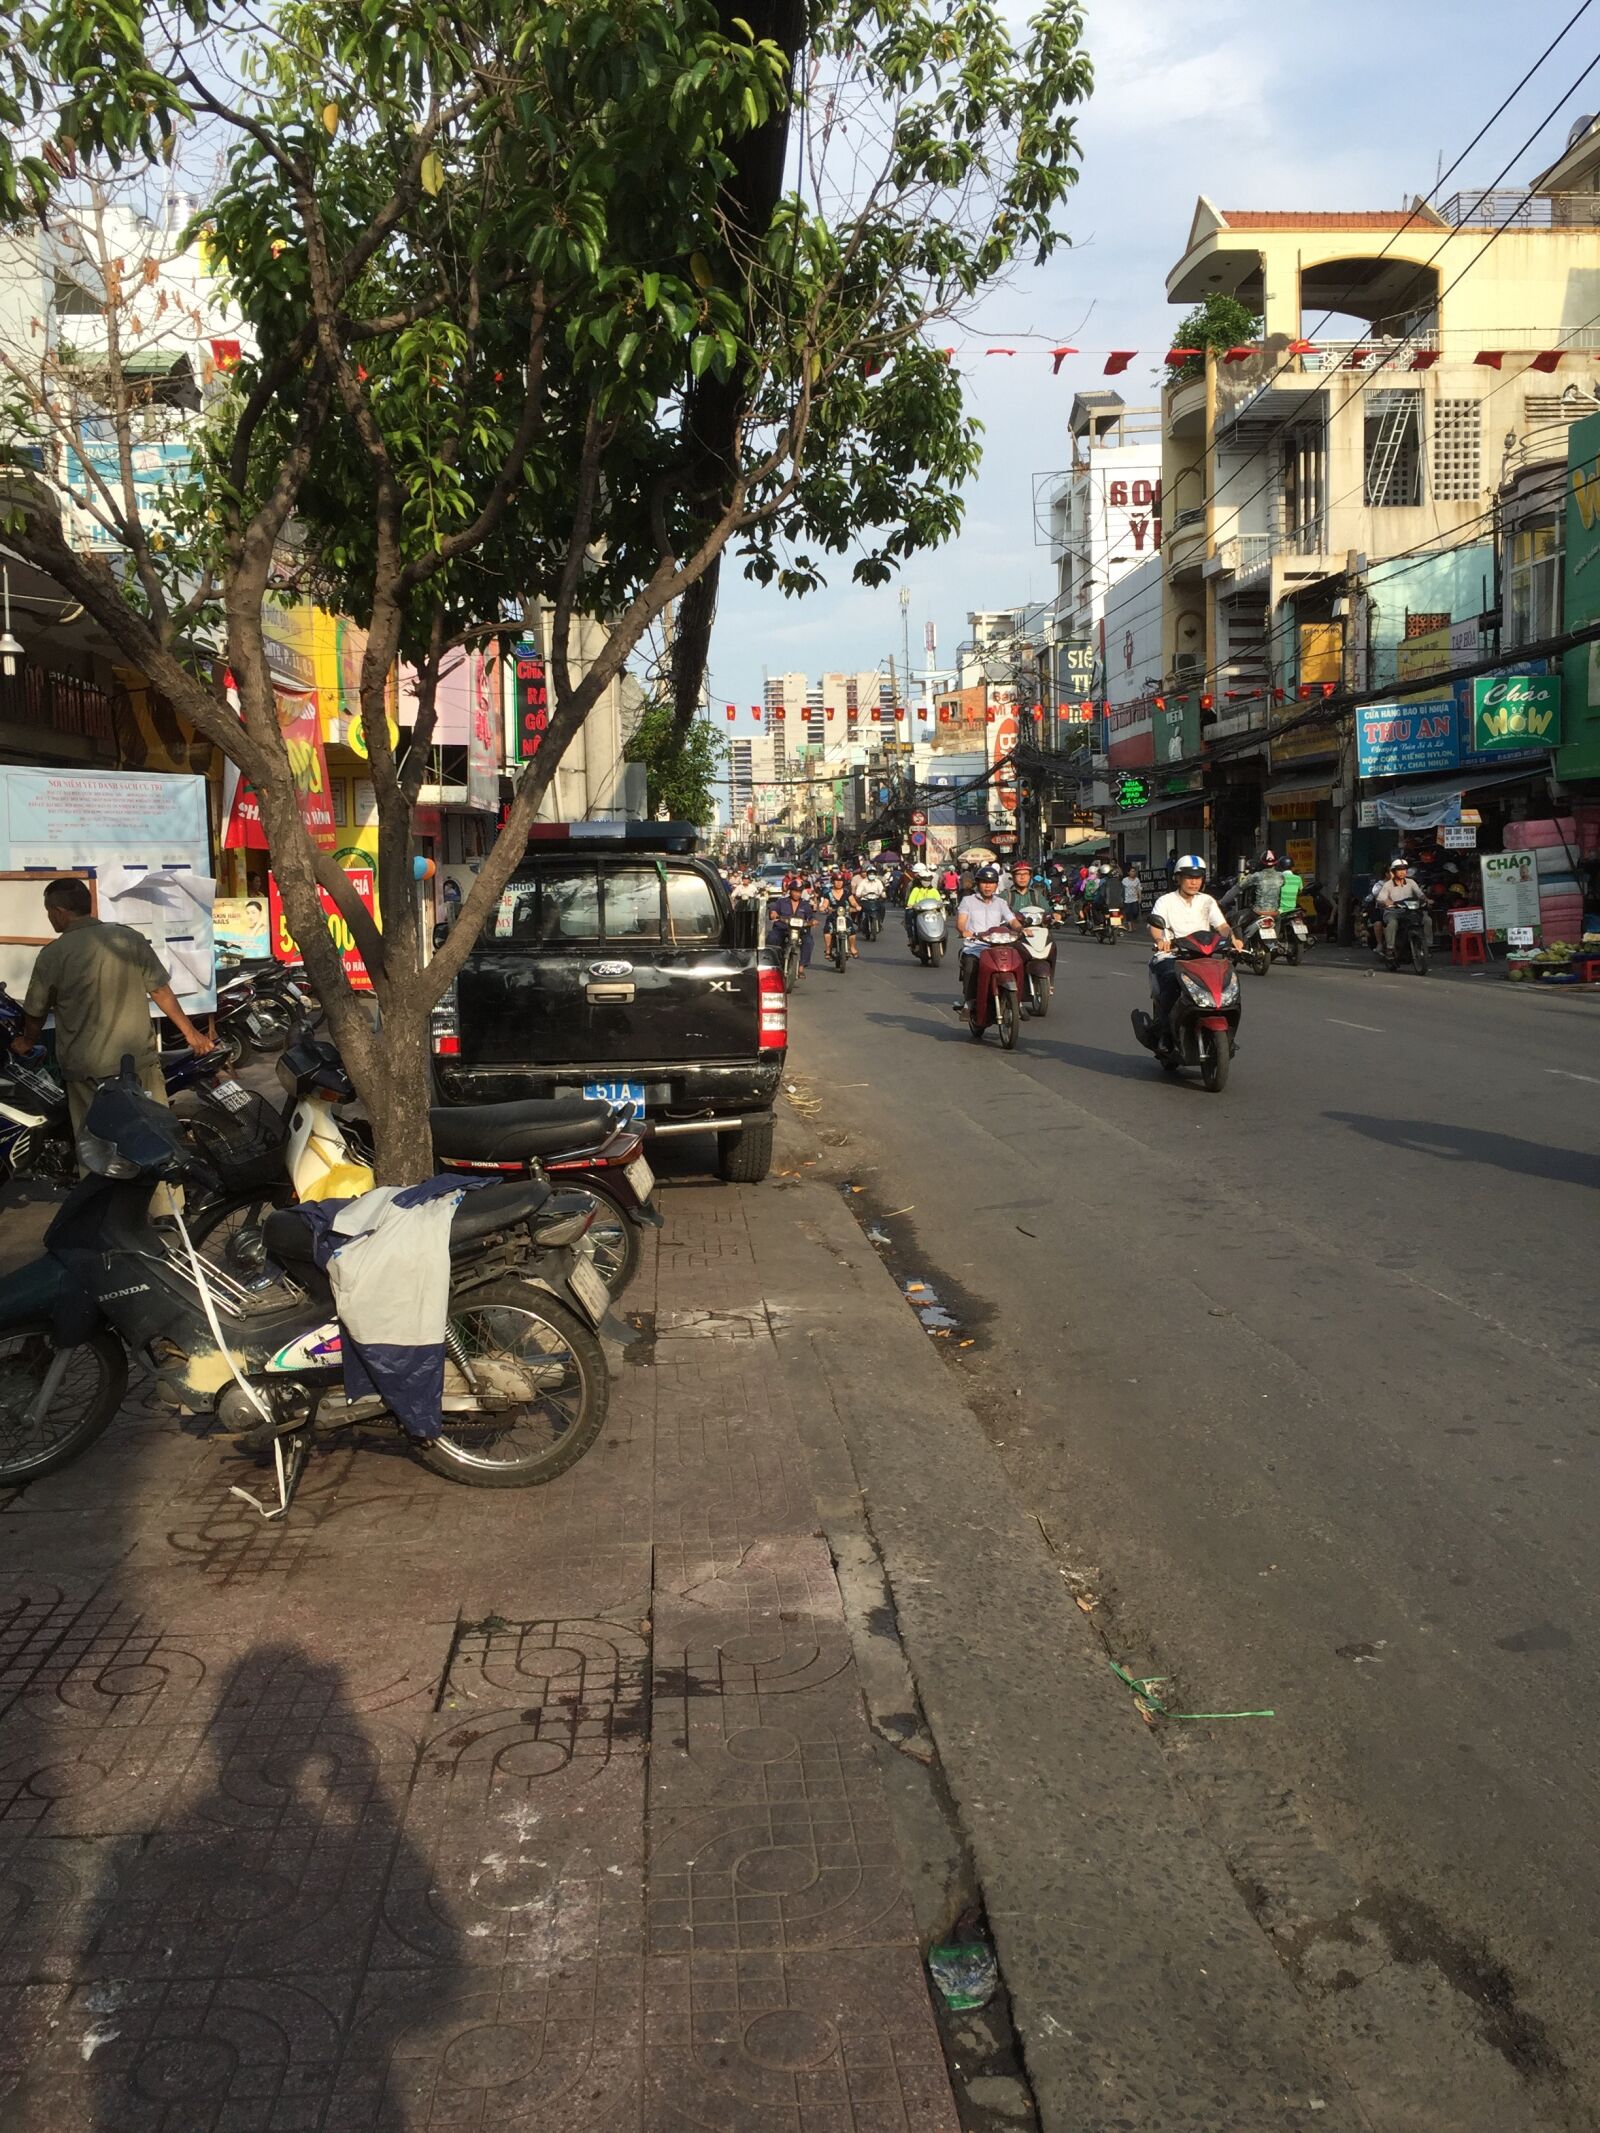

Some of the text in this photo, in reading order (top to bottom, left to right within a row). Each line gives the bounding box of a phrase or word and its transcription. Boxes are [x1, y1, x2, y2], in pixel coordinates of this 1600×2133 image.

[1483, 682, 1551, 706] Cháo
[1381, 708, 1401, 719] HÀNG
[1403, 707, 1418, 717] BAO
[1429, 703, 1449, 714] NHỰA
[1364, 716, 1451, 744] THU AN
[1408, 760, 1426, 769] CHAI
[1486, 855, 1532, 872] CHÁO
[599, 962, 624, 974] Ford
[709, 980, 741, 992] XL
[596, 1083, 631, 1100] 51A
[98, 1283, 151, 1302] HONDA
